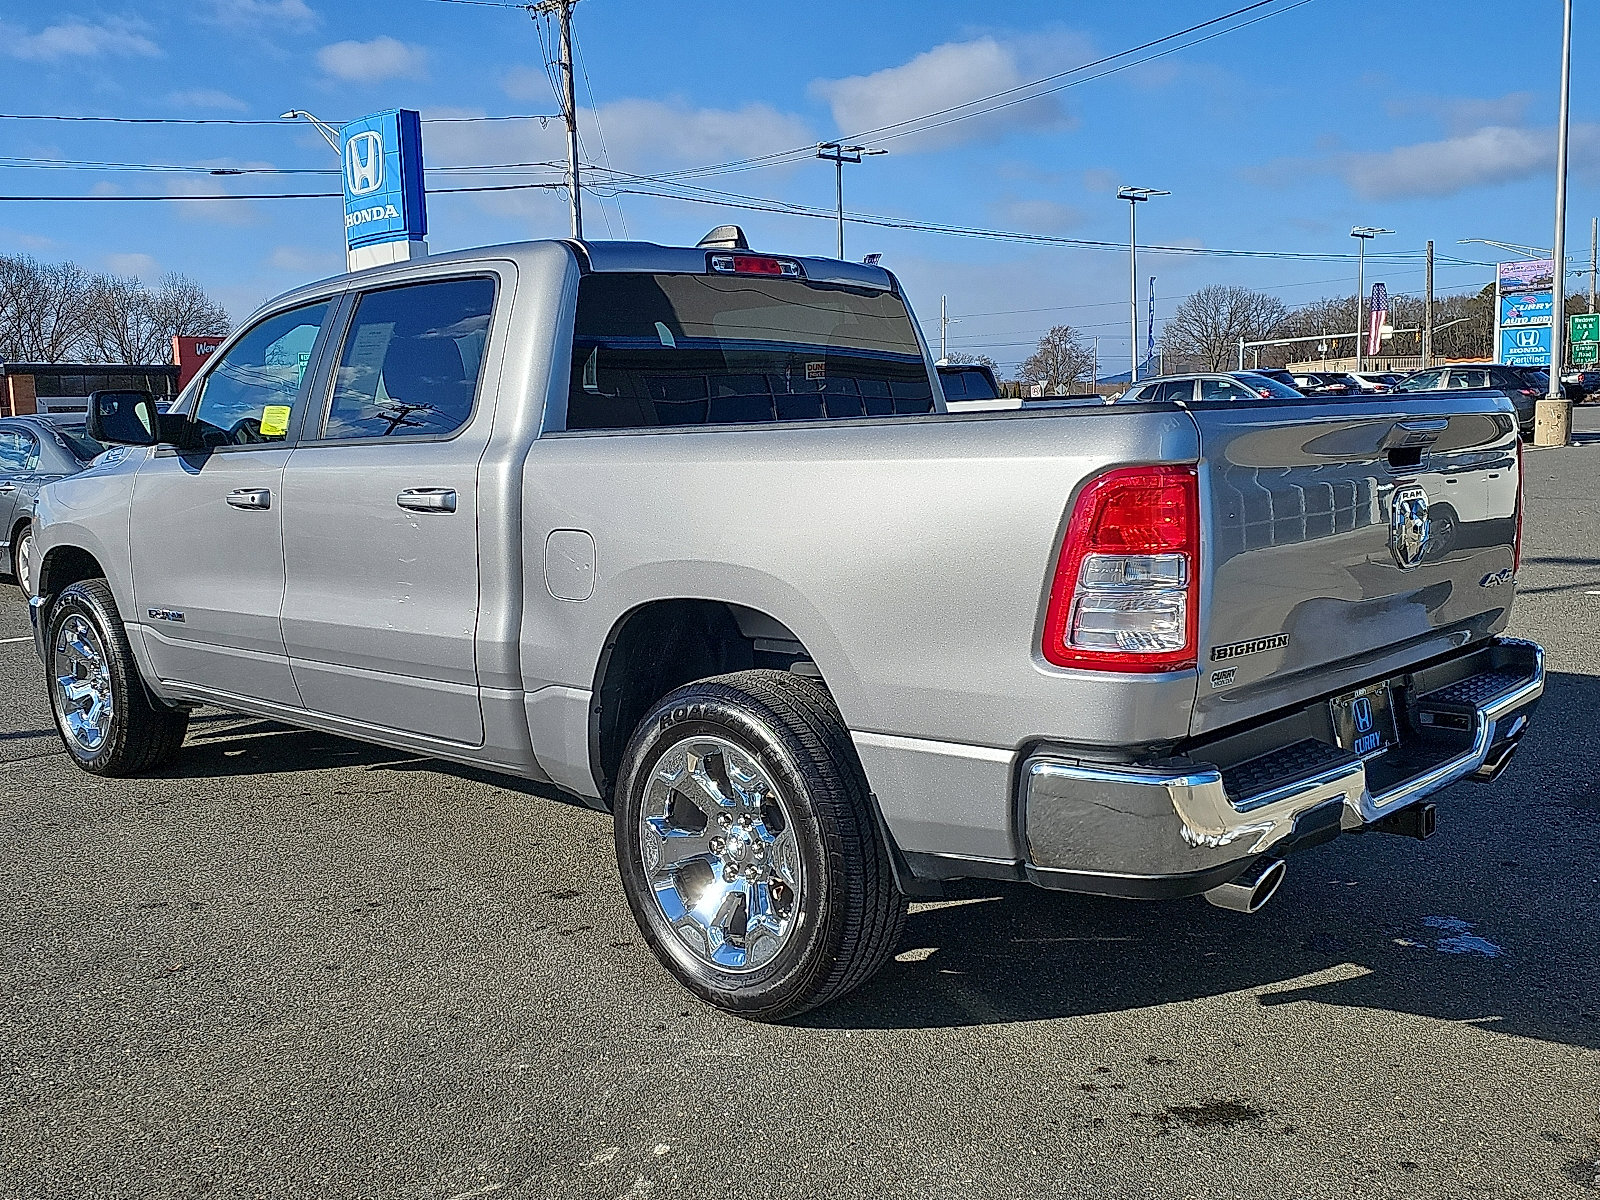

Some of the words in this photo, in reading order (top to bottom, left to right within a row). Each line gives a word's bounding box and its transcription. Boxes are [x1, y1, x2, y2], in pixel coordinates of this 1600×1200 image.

[345, 204, 399, 227] HONDA
[1504, 317, 1529, 325] AUTO
[1402, 490, 1422, 499] RAM
[1213, 633, 1289, 661] BIGHORN
[1354, 731, 1381, 755] CURRY
